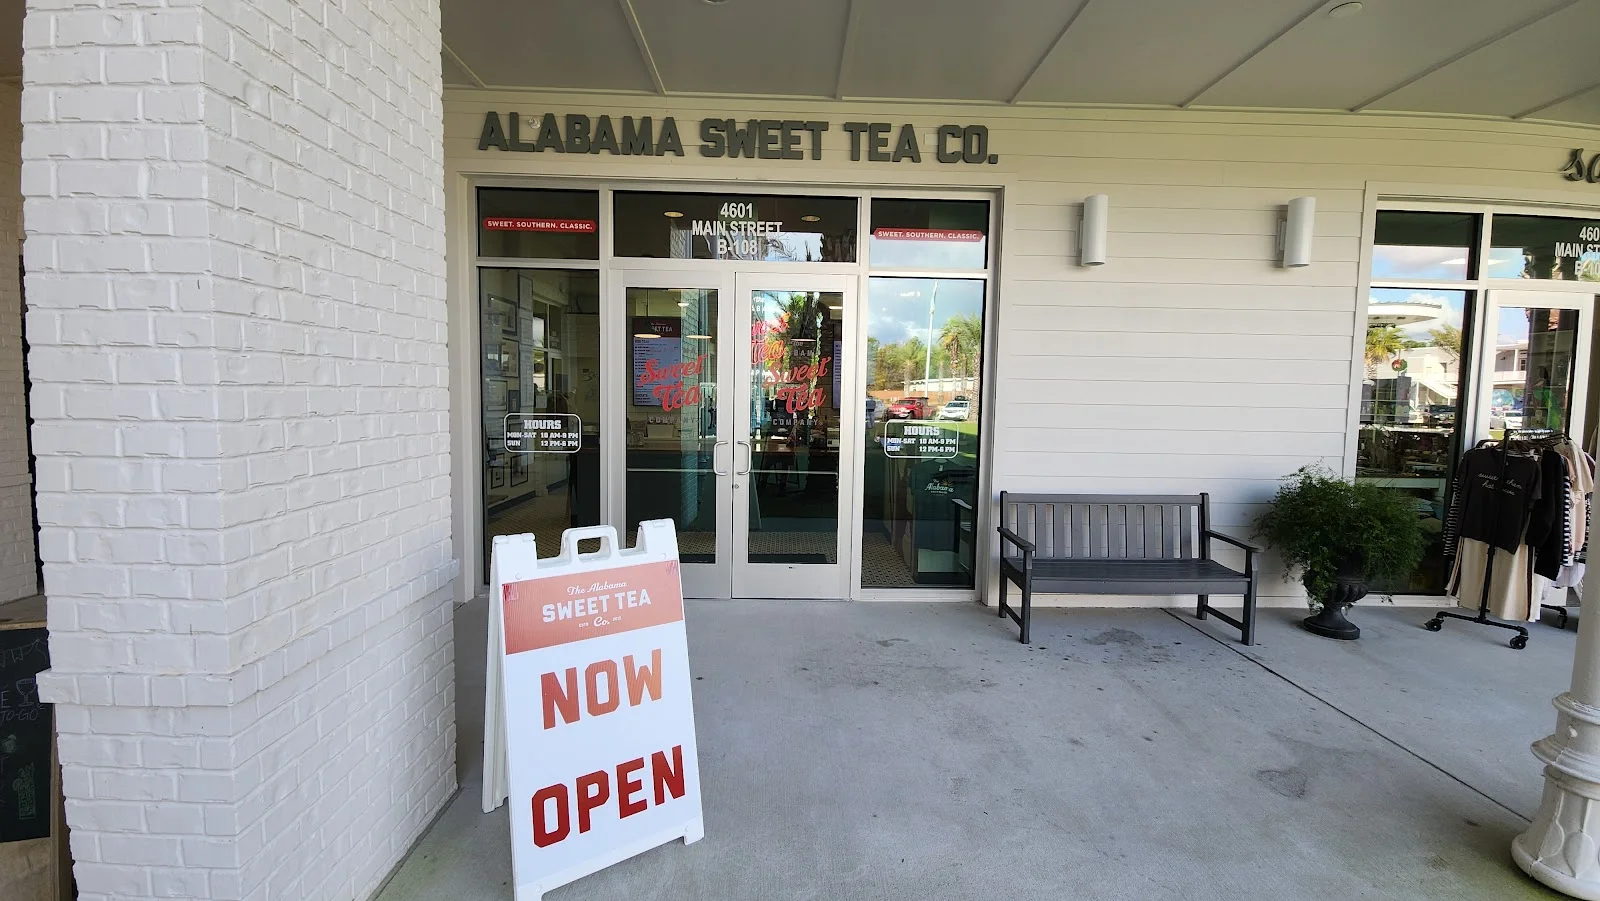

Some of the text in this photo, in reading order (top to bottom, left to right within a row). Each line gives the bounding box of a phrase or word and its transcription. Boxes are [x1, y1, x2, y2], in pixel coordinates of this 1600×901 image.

[478, 110, 999, 164] ALABAMA SWEET TEA CO.
[720, 202, 753, 218] 4601
[487, 220, 515, 228] SWEET.
[516, 221, 558, 229] SOUTHERN.
[692, 220, 782, 237] MAIN STREET
[878, 230, 980, 240] SWEET. SOUTHERN. CLASSIC.
[717, 239, 758, 255] B-108
[1555, 242, 1584, 258] MAIN
[638, 354, 708, 388] Sweet
[763, 356, 831, 387] Sweet
[652, 380, 703, 412] Tea
[776, 382, 826, 413] Tea
[523, 419, 562, 430] HOURS
[772, 418, 819, 426] COMPANY
[567, 432, 579, 440] PM
[903, 425, 940, 436] HOURS
[567, 581, 628, 596] The Alabama
[542, 588, 652, 623] SWEET TEA
[593, 616, 611, 627] Co.
[540, 648, 663, 731] NOW
[531, 744, 686, 848] OPEN
